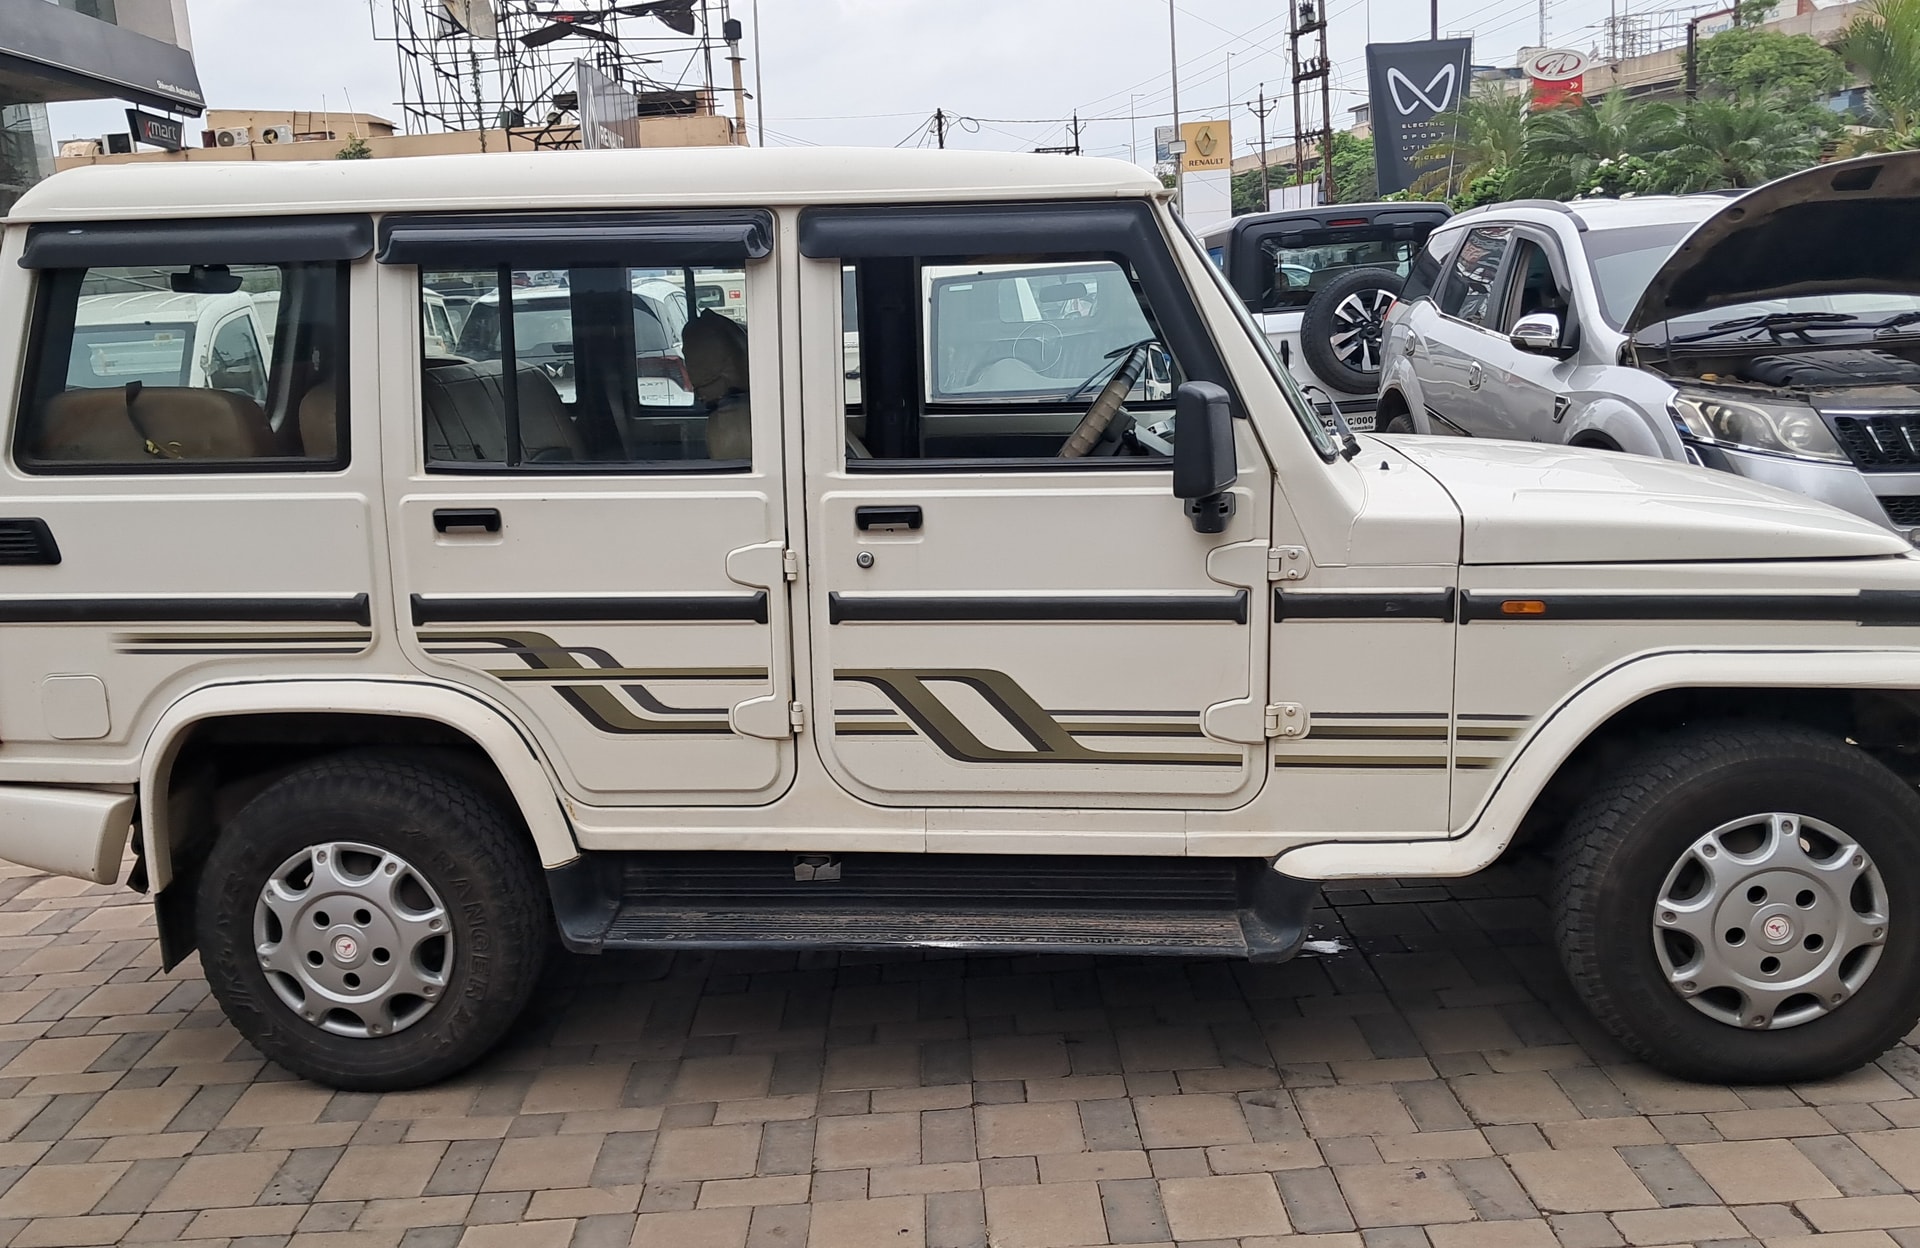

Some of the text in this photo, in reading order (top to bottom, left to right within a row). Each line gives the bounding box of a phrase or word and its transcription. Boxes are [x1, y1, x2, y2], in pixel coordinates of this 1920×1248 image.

[1401, 121, 1445, 129] ELECTRIC
[1402, 132, 1445, 140] SPORT
[1188, 157, 1224, 167] RENAULT
